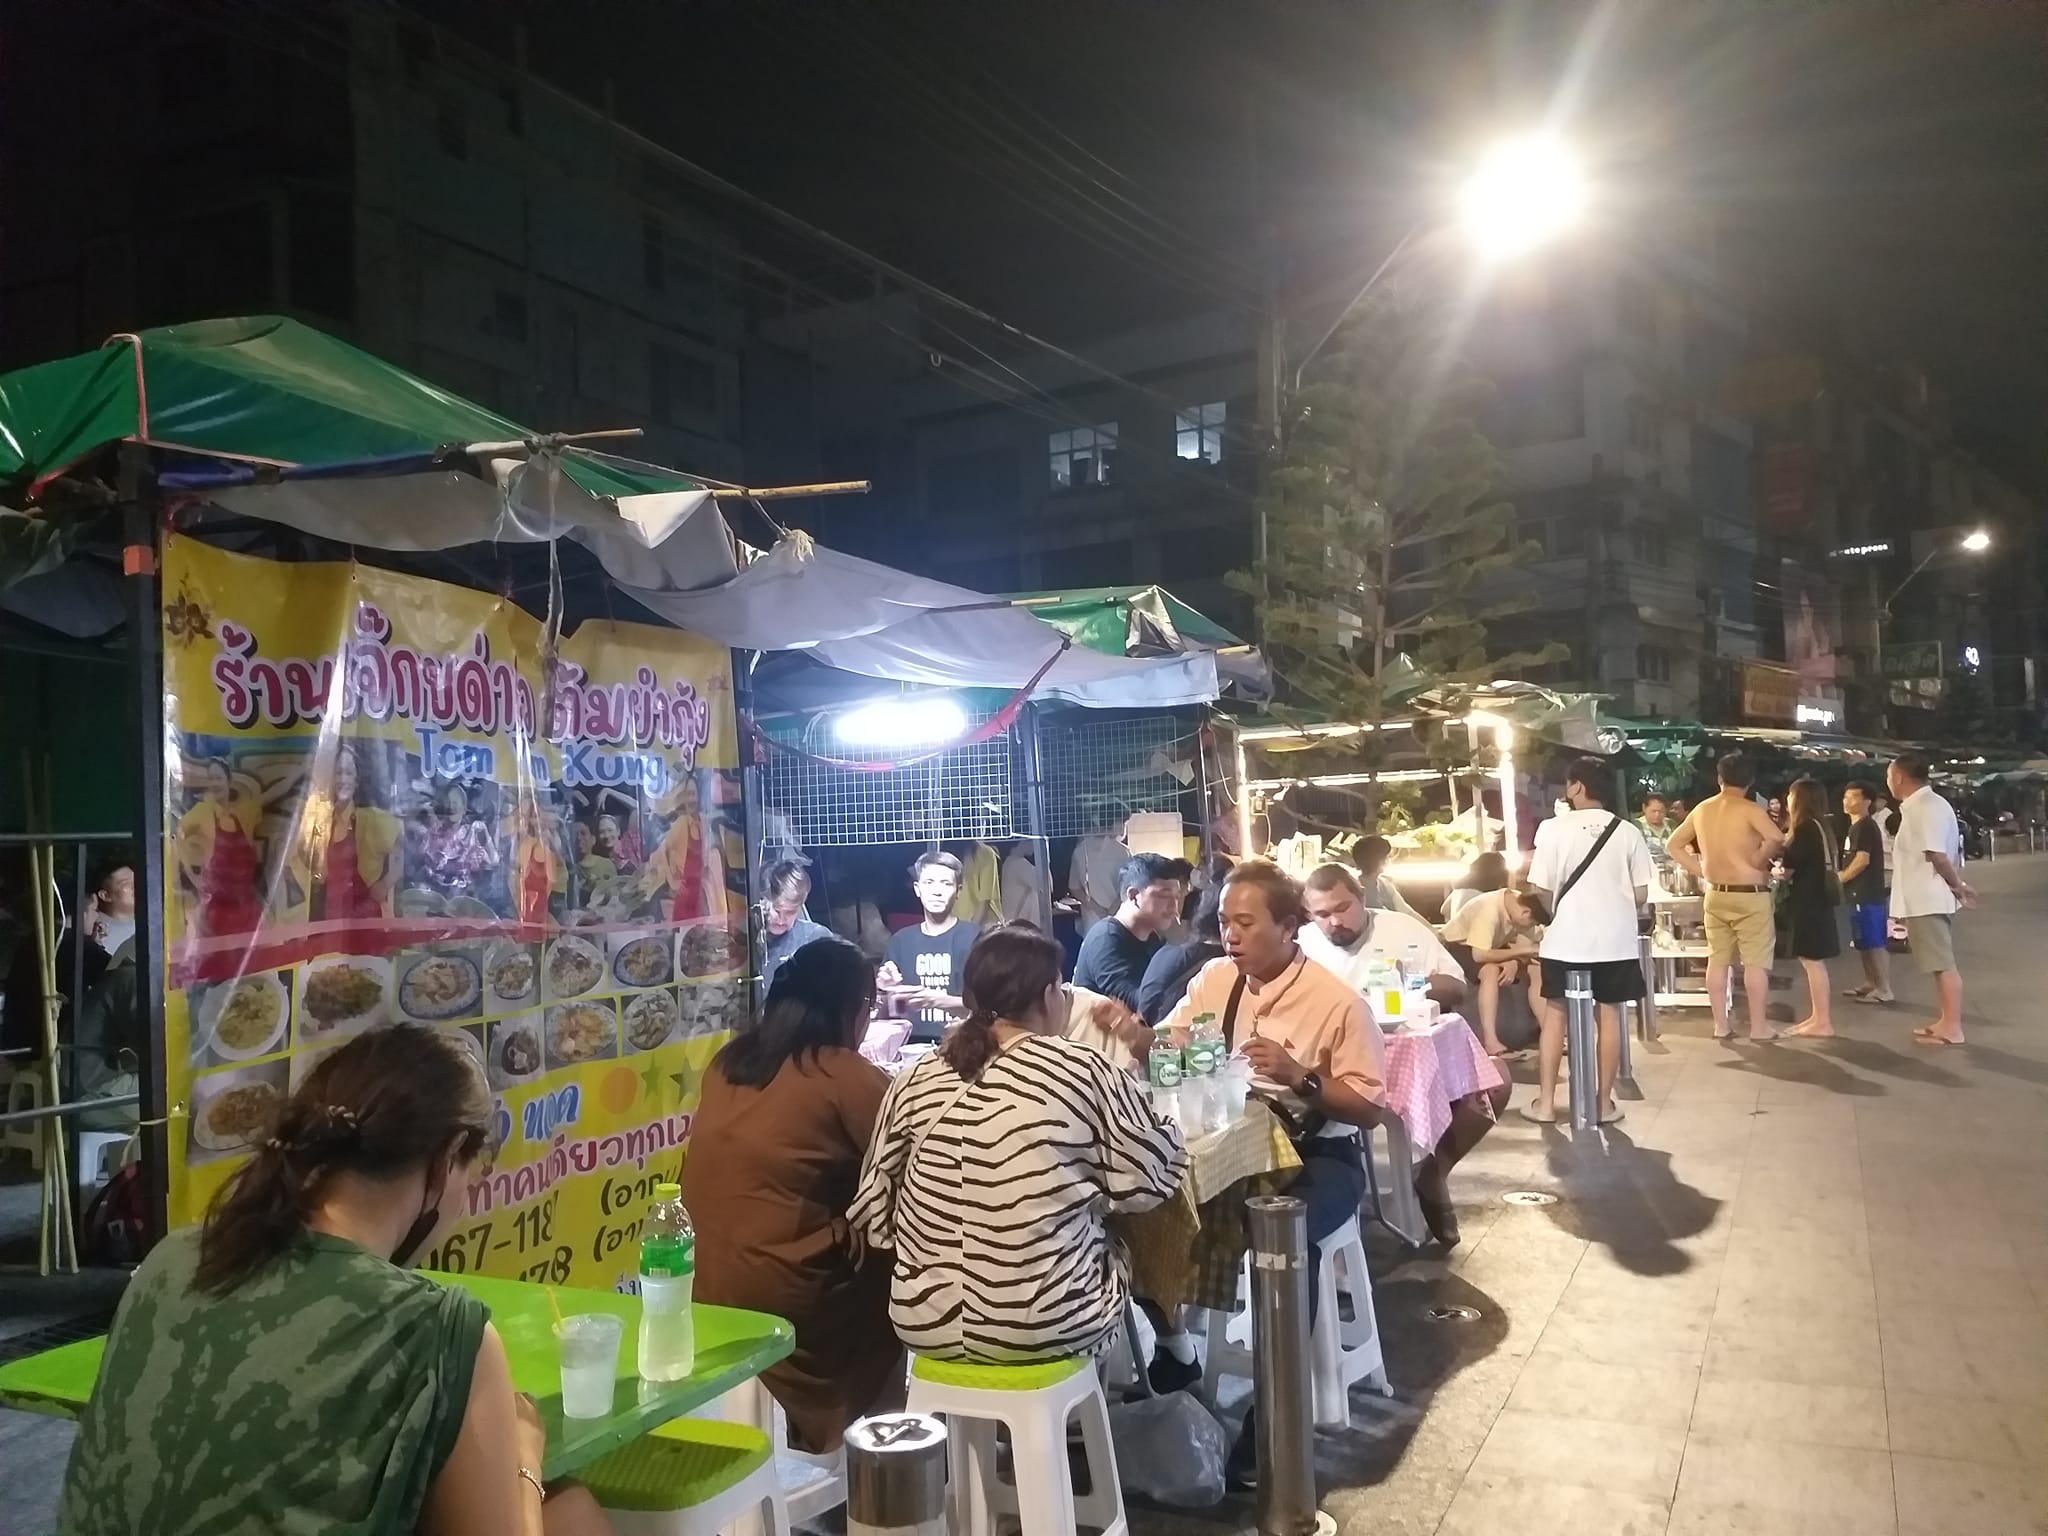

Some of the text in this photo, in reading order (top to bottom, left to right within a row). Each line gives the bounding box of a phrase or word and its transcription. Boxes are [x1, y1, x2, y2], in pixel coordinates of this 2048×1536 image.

[414, 727, 493, 775] Tom
[565, 744, 664, 797] Kung
[915, 952, 952, 976] GOOD
